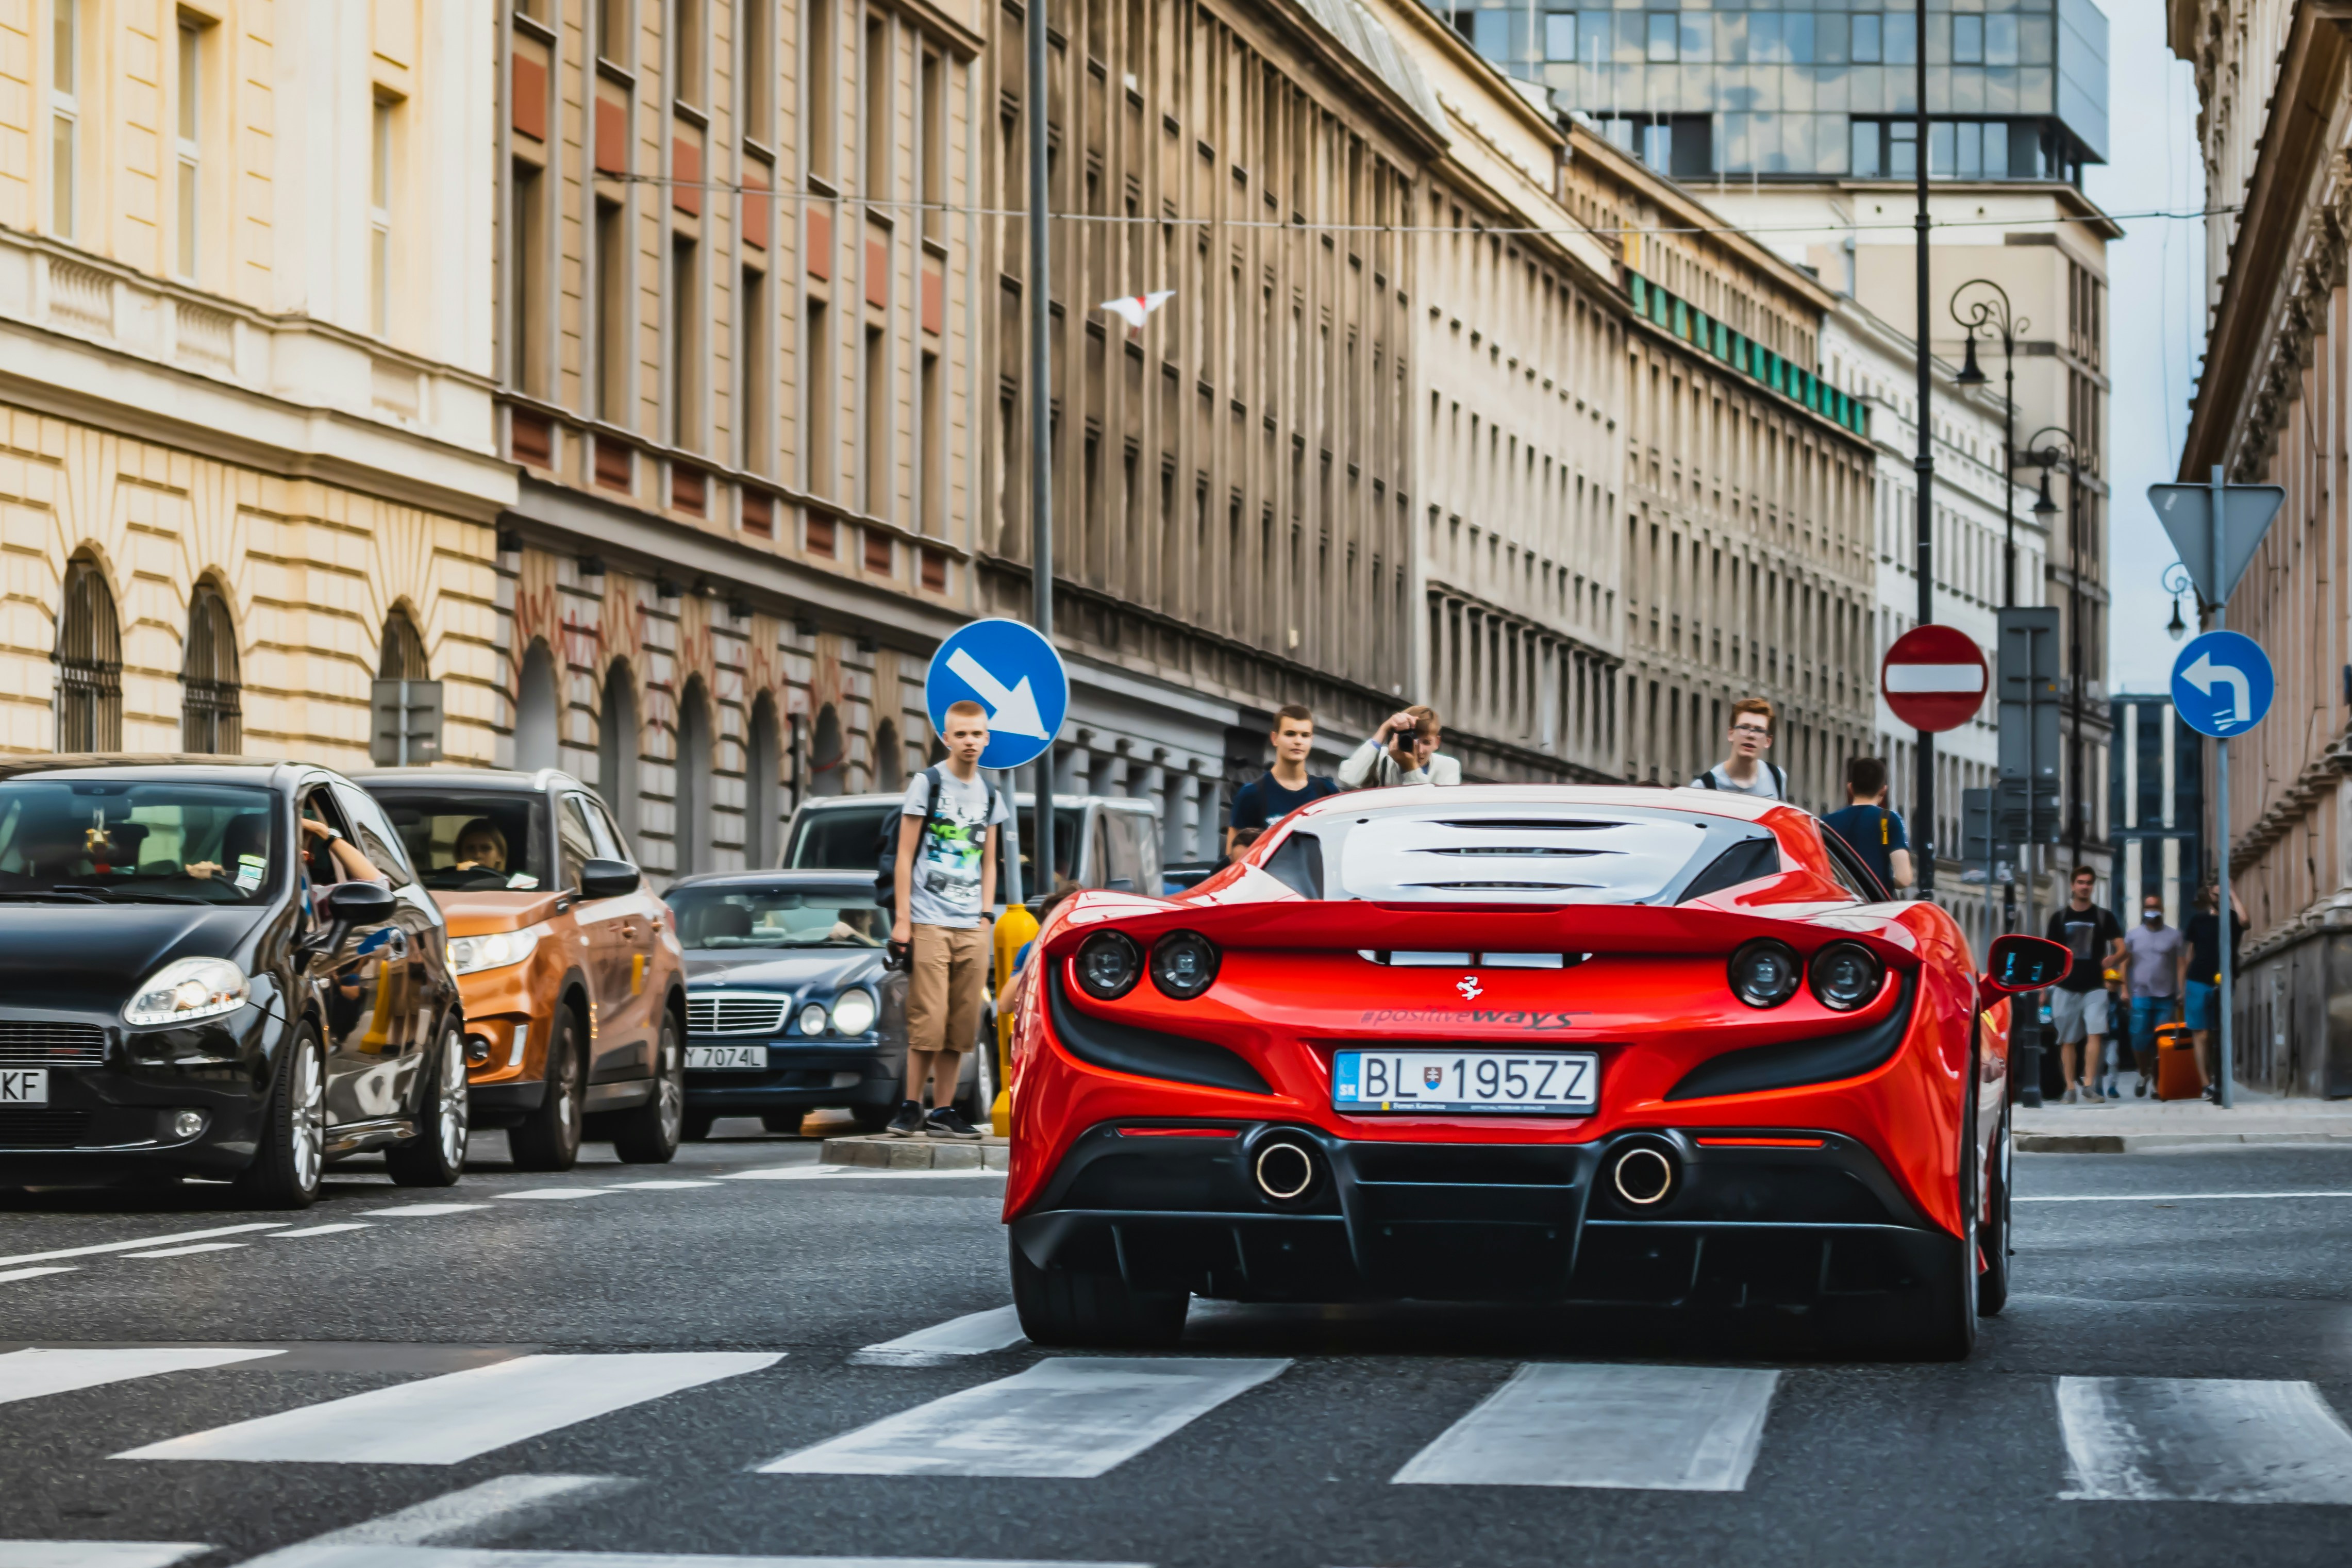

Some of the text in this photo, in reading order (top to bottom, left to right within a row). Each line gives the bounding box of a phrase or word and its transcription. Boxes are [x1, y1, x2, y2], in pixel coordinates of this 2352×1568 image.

[704, 1048, 760, 1066] 7074L
[3, 1072, 39, 1099] KF
[1366, 1058, 1587, 1099] BL 195ZZ
[1340, 1084, 1356, 1096] SK
